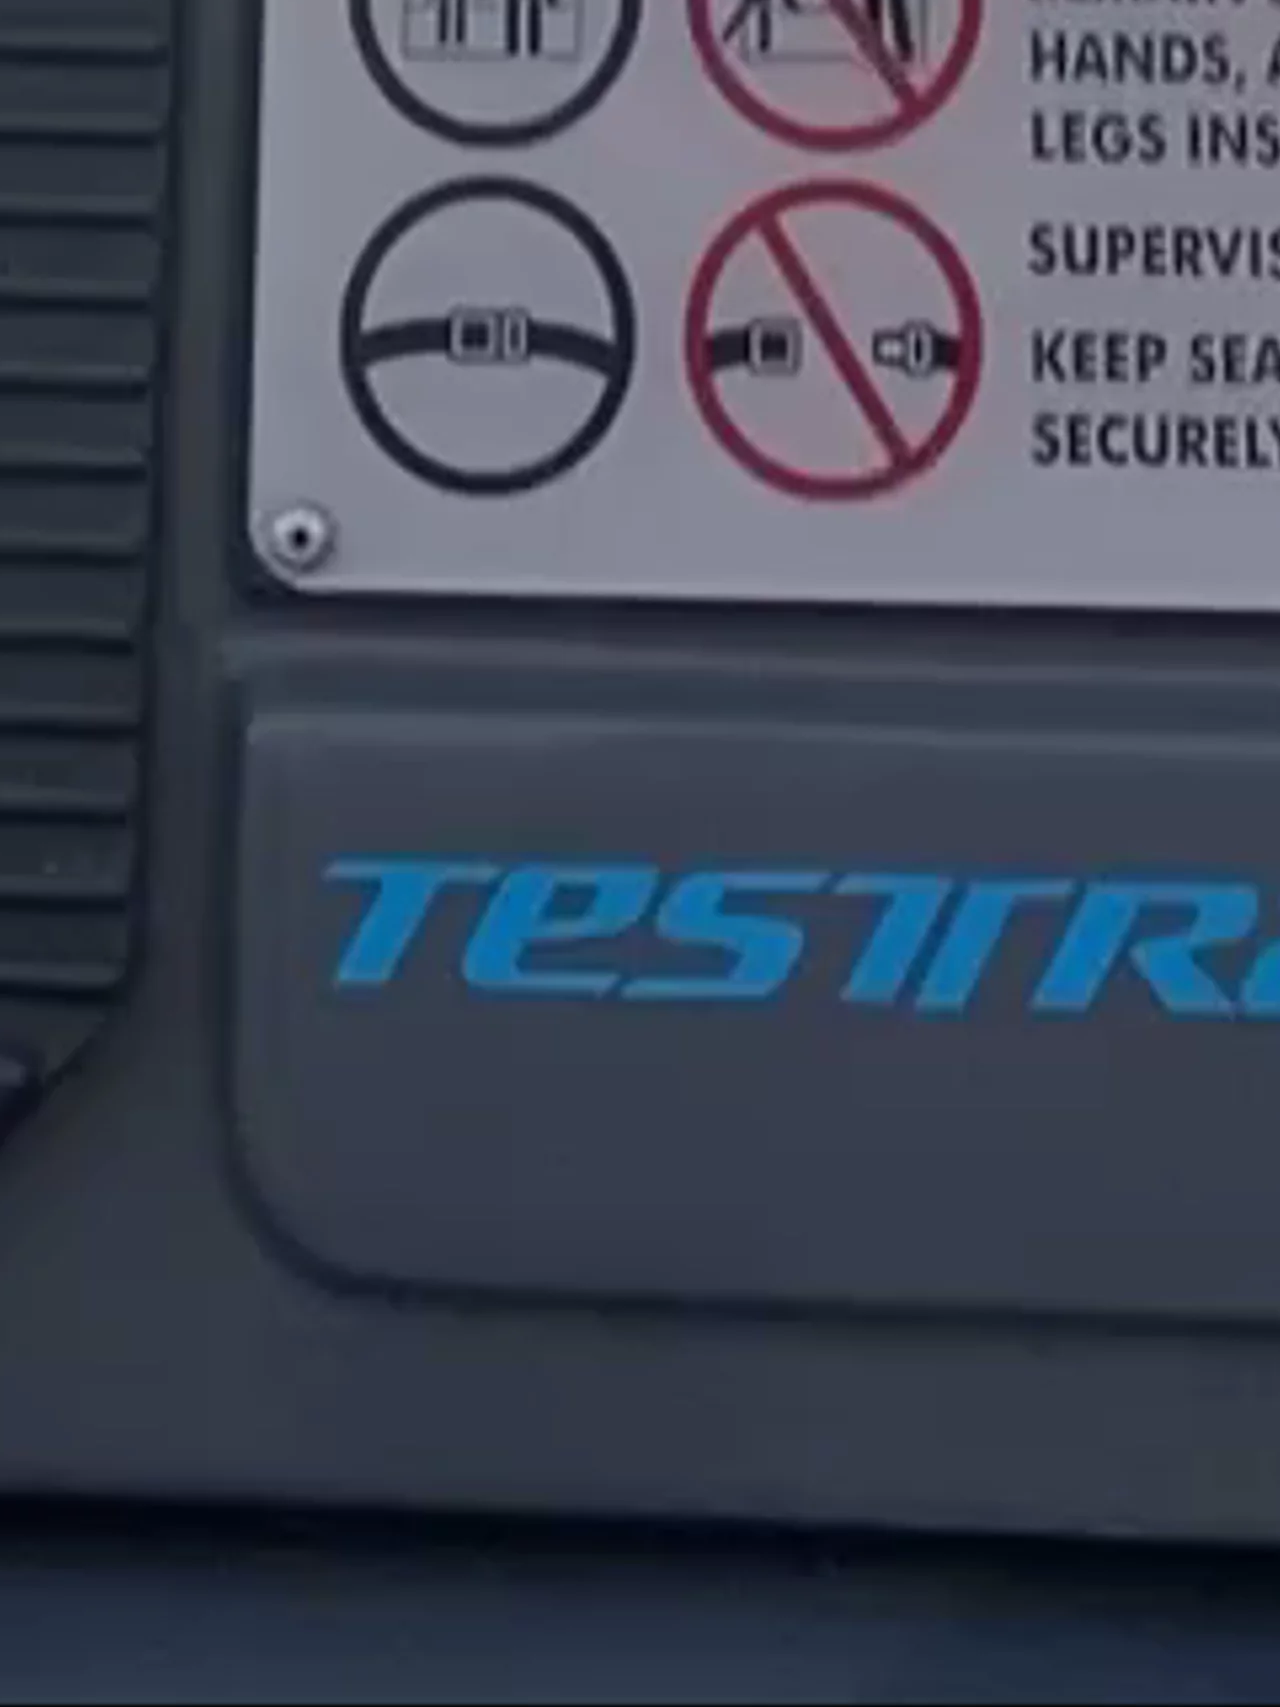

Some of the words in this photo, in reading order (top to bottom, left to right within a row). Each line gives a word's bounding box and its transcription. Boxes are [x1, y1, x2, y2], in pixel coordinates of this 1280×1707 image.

[1029, 28, 1247, 94] HANDS,
[1030, 110, 1168, 165] LEGS
[1031, 329, 1168, 384] KEEP
